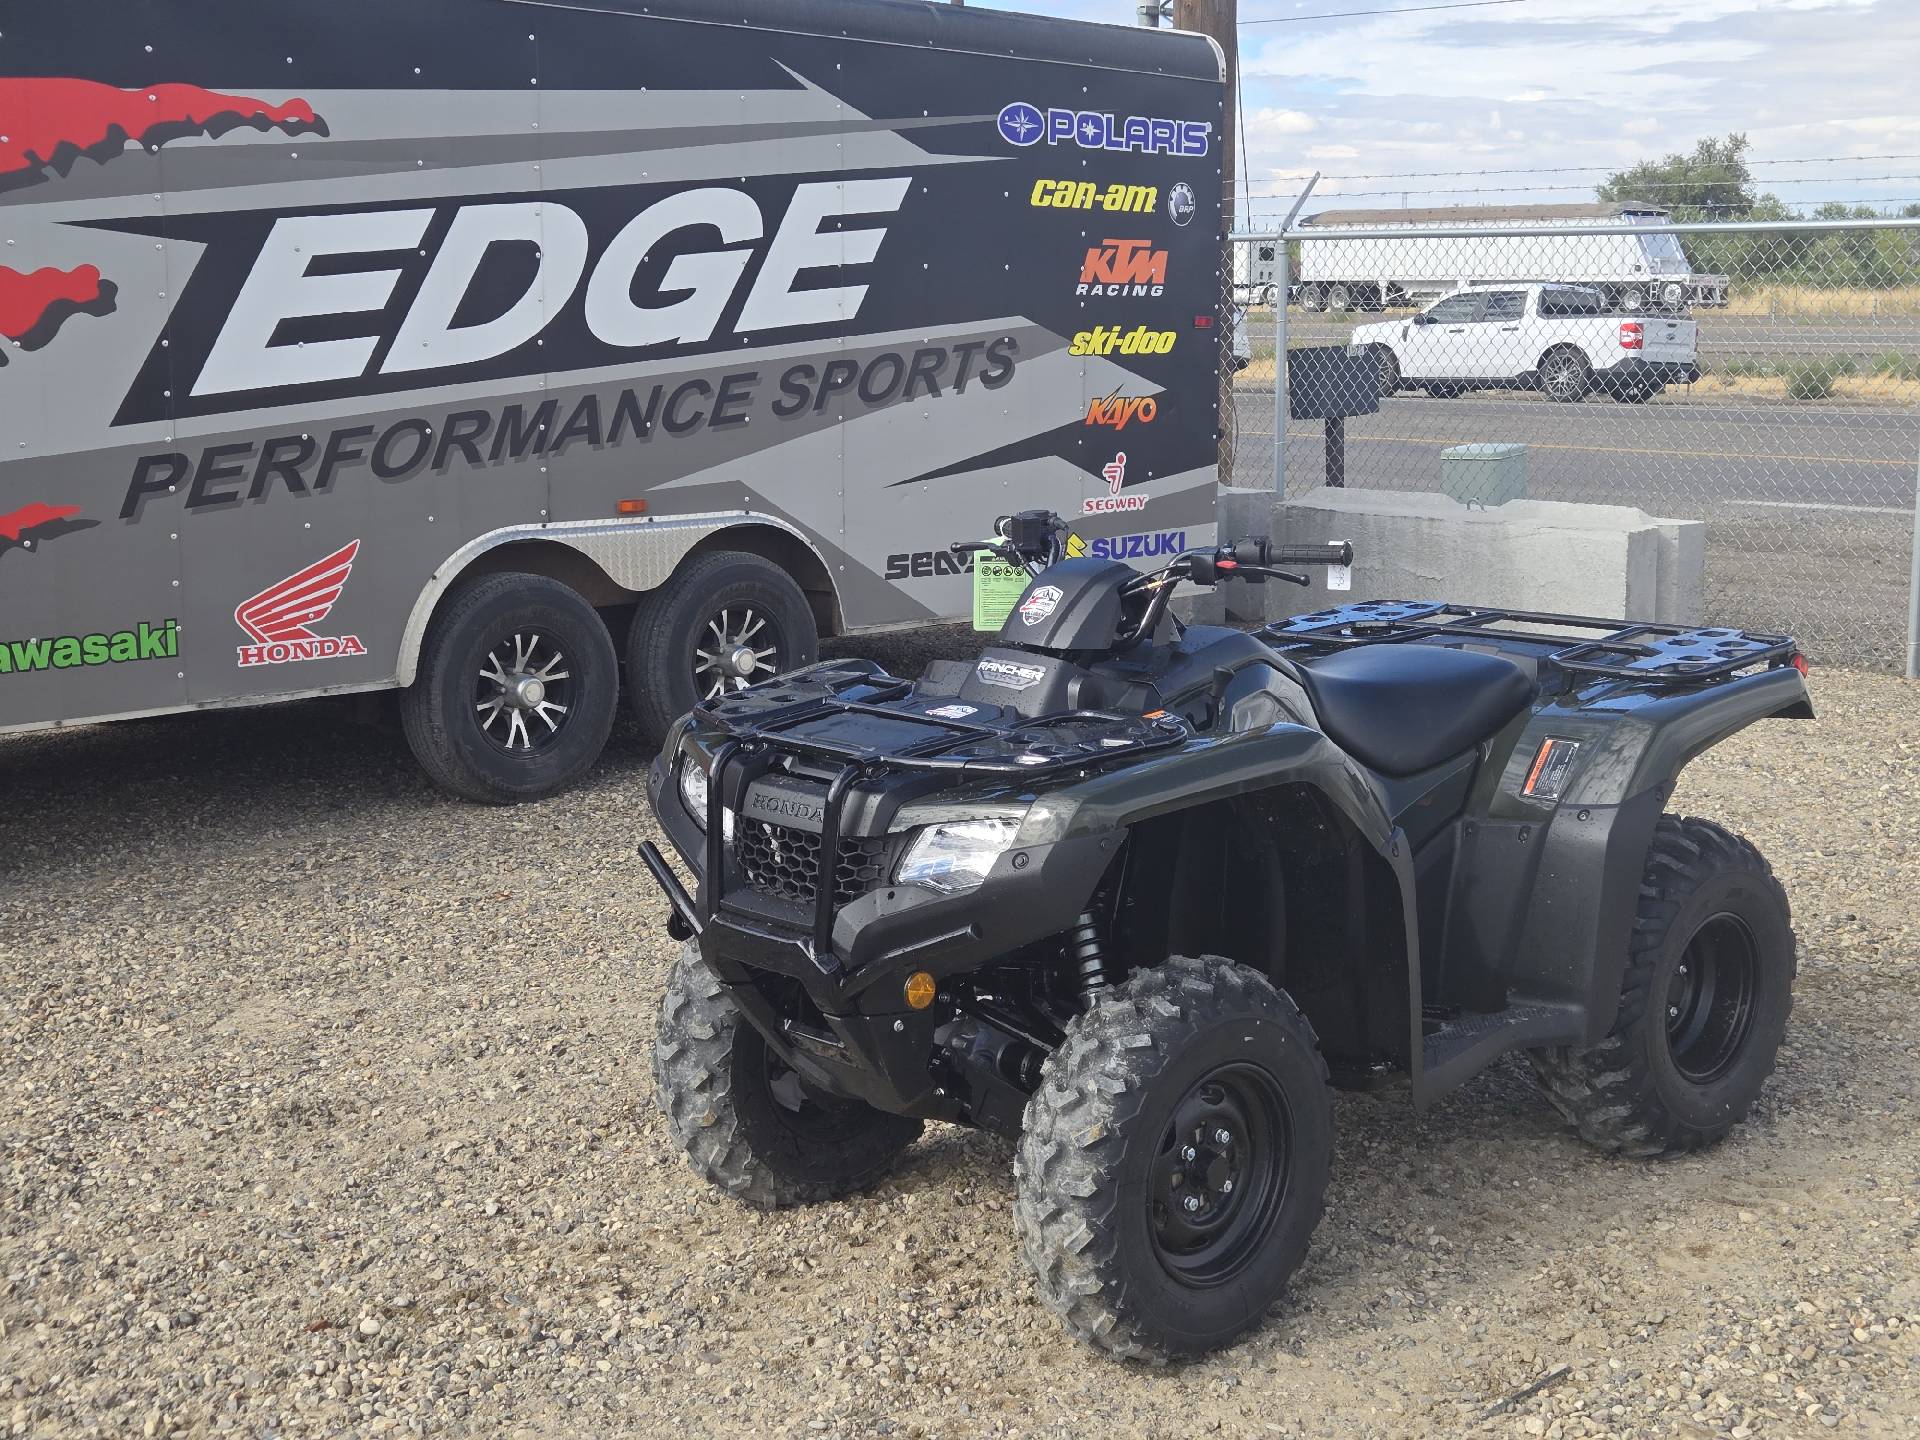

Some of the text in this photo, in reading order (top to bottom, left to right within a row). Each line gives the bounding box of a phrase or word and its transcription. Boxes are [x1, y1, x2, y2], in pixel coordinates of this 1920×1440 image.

[1048, 108, 1210, 157] POLARIS
[1030, 179, 1158, 213] can-am
[1079, 238, 1169, 284] KTM
[189, 176, 913, 397] EDGE
[1076, 284, 1164, 297] RACING
[1068, 325, 1177, 357] ski-doo
[119, 334, 1020, 521] PERFORMANCE SPORTS
[1083, 494, 1148, 514] SEGWAY
[1091, 531, 1186, 561] SUZUKI
[238, 634, 368, 668] HONDA
[977, 660, 1045, 682] RANCHER
[751, 793, 825, 824] HONDA
